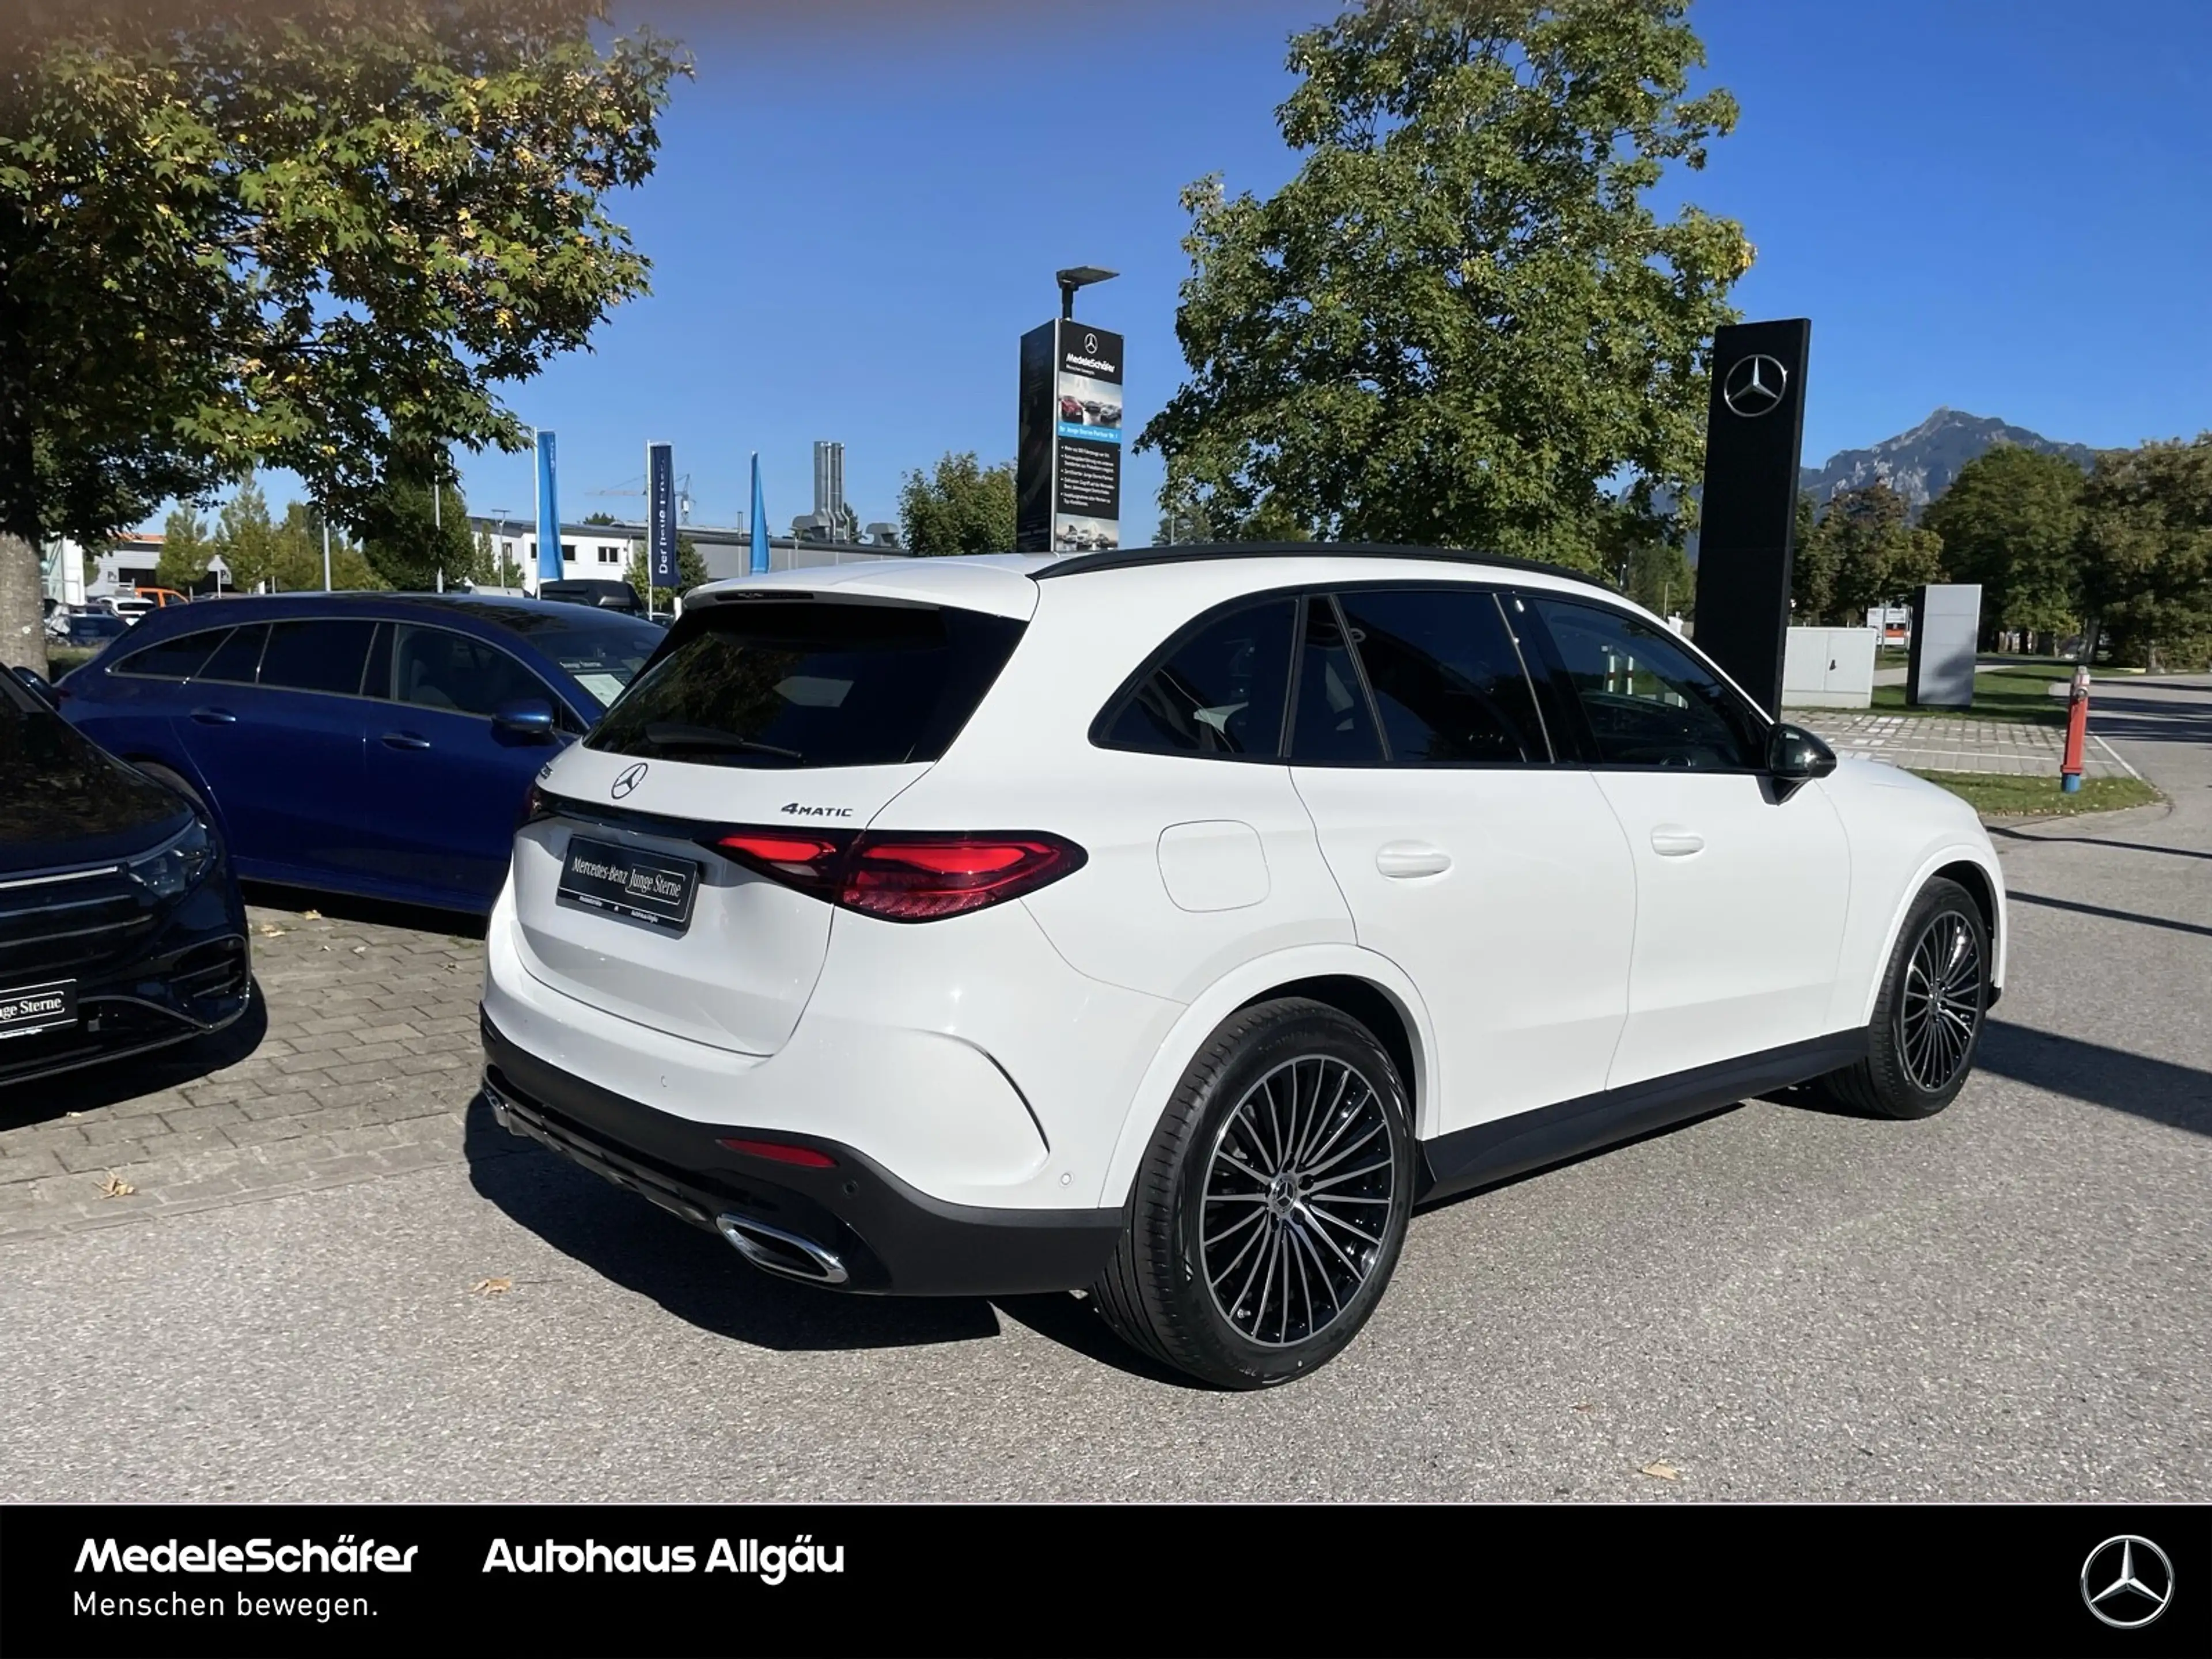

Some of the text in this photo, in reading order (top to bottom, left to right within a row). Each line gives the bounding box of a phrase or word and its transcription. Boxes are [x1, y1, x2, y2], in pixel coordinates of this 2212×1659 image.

[658, 549, 668, 574] Der
[781, 802, 853, 817] 4MATIC
[571, 857, 682, 897] Mercedes-Benz Junge Sterne
[20, 998, 62, 1014] Sterne
